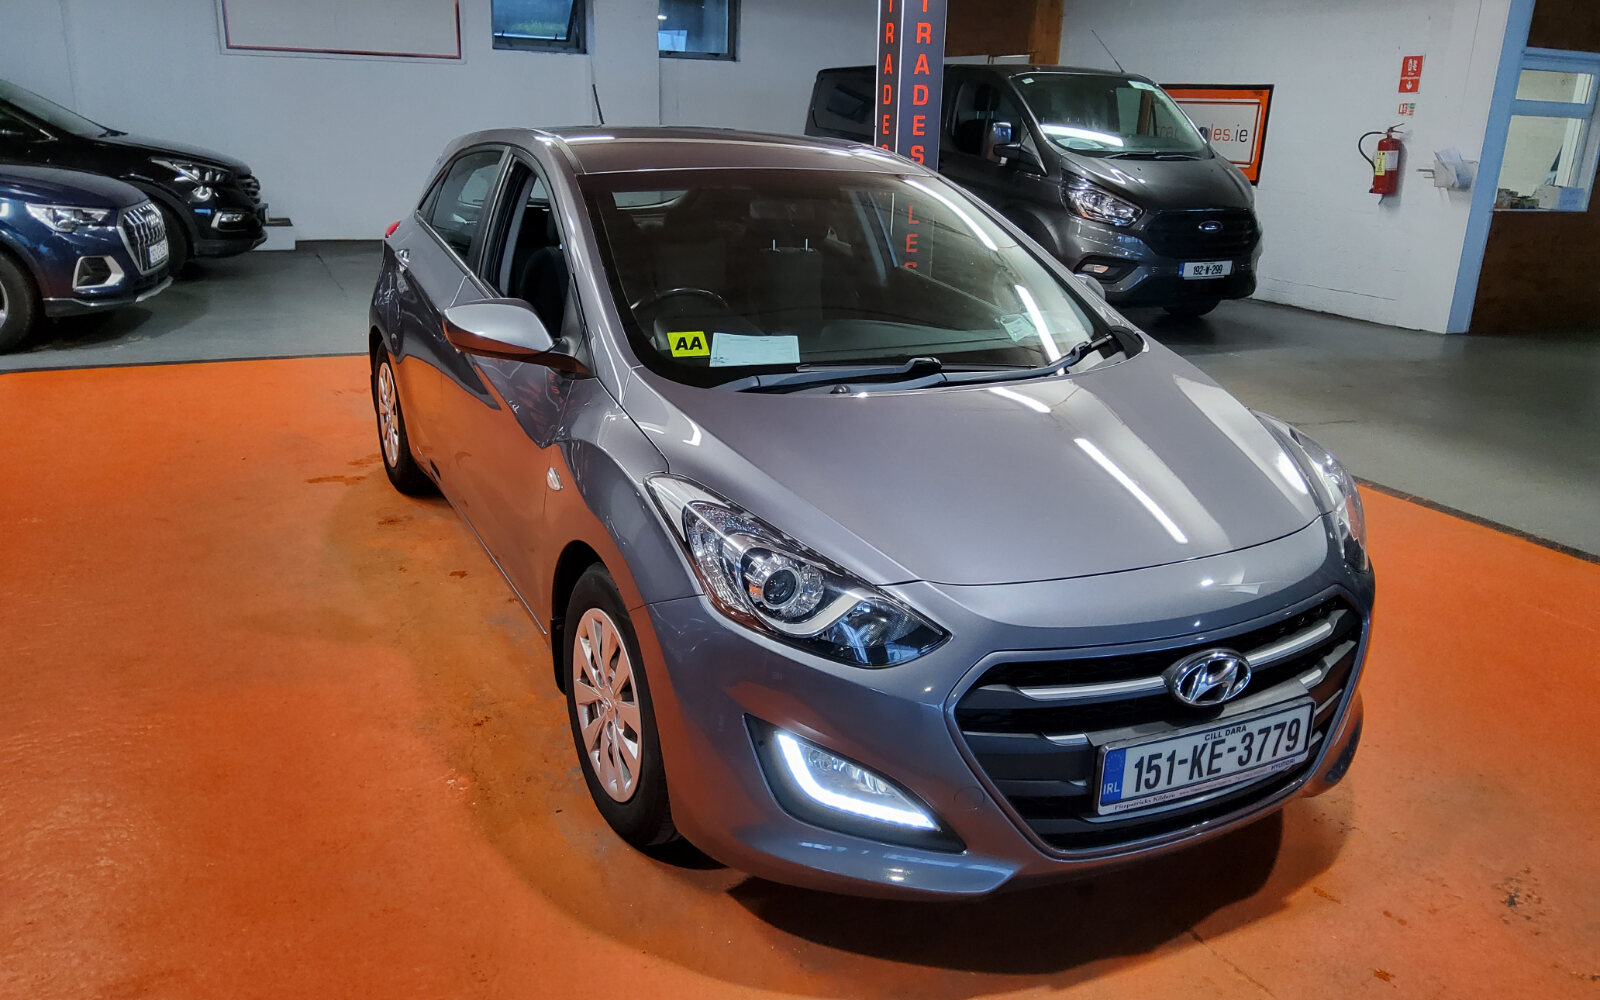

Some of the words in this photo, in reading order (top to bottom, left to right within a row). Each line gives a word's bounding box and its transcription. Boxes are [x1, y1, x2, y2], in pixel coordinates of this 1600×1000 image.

[881, 0, 895, 150] TRADE
[675, 337, 702, 351] AA
[1204, 733, 1223, 742] CILL
[1225, 725, 1247, 737] DARA
[1134, 718, 1301, 792] 151-KE-3779
[1103, 781, 1120, 795] IRL
